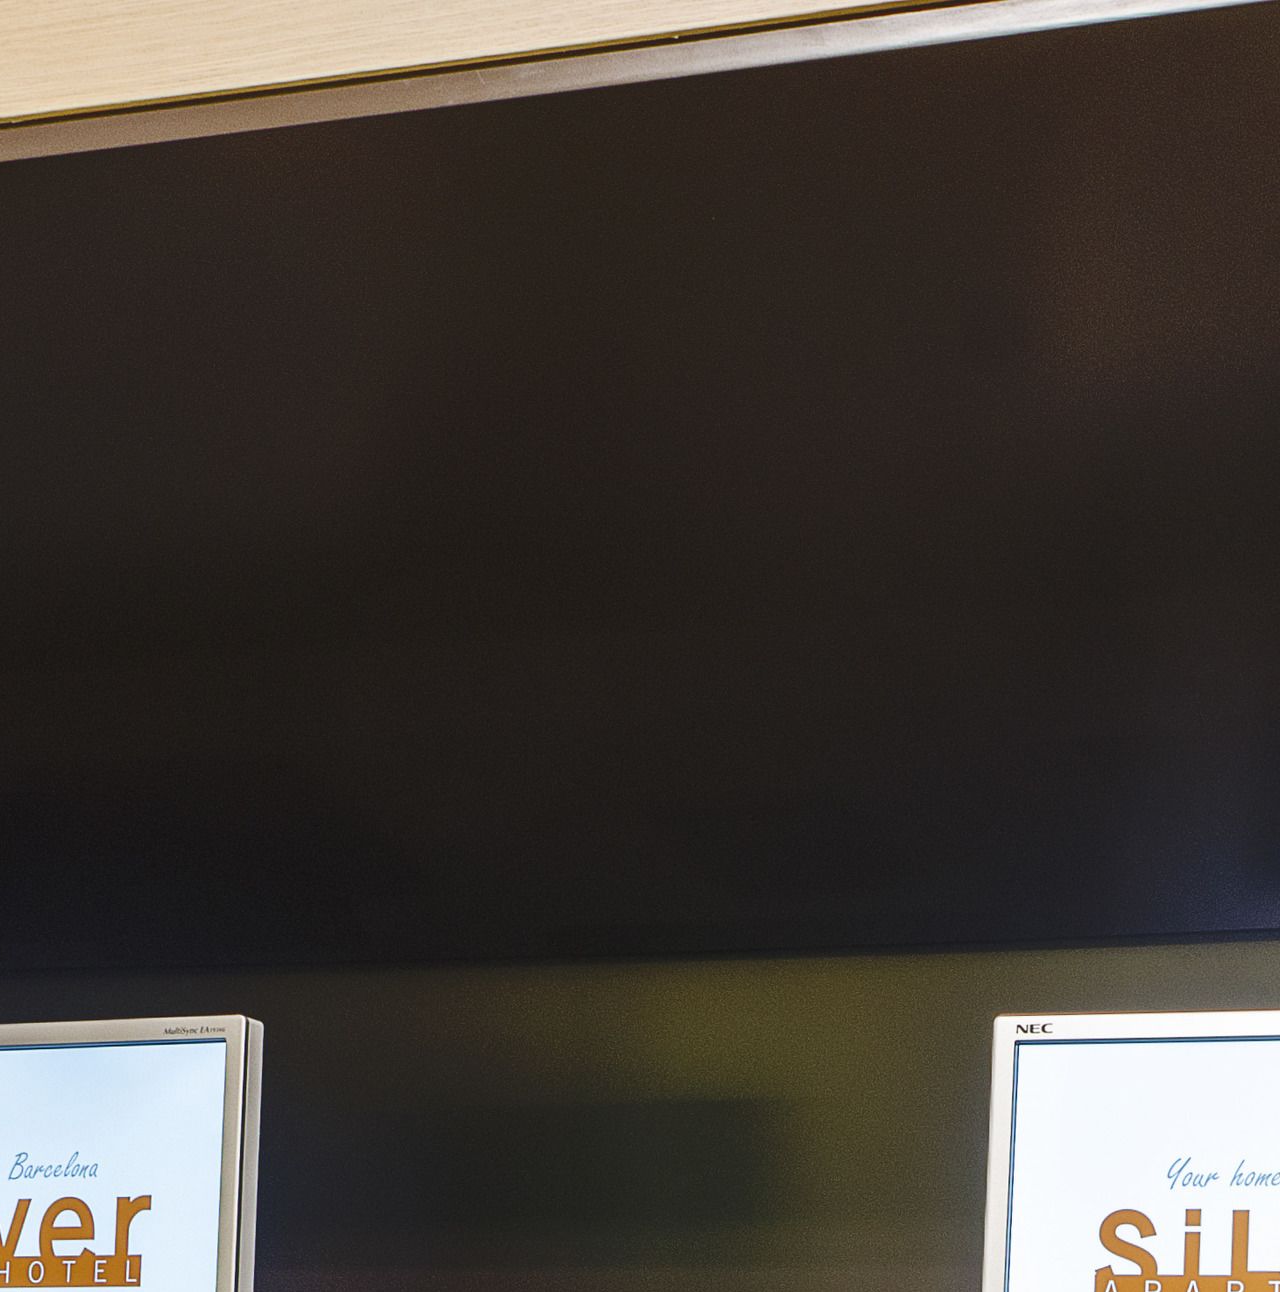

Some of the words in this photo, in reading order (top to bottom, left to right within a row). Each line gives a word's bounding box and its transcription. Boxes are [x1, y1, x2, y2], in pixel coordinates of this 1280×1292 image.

[1016, 1023, 1054, 1034] NEC
[7, 1151, 99, 1180] Barcelona
[1166, 1156, 1220, 1190] Your
